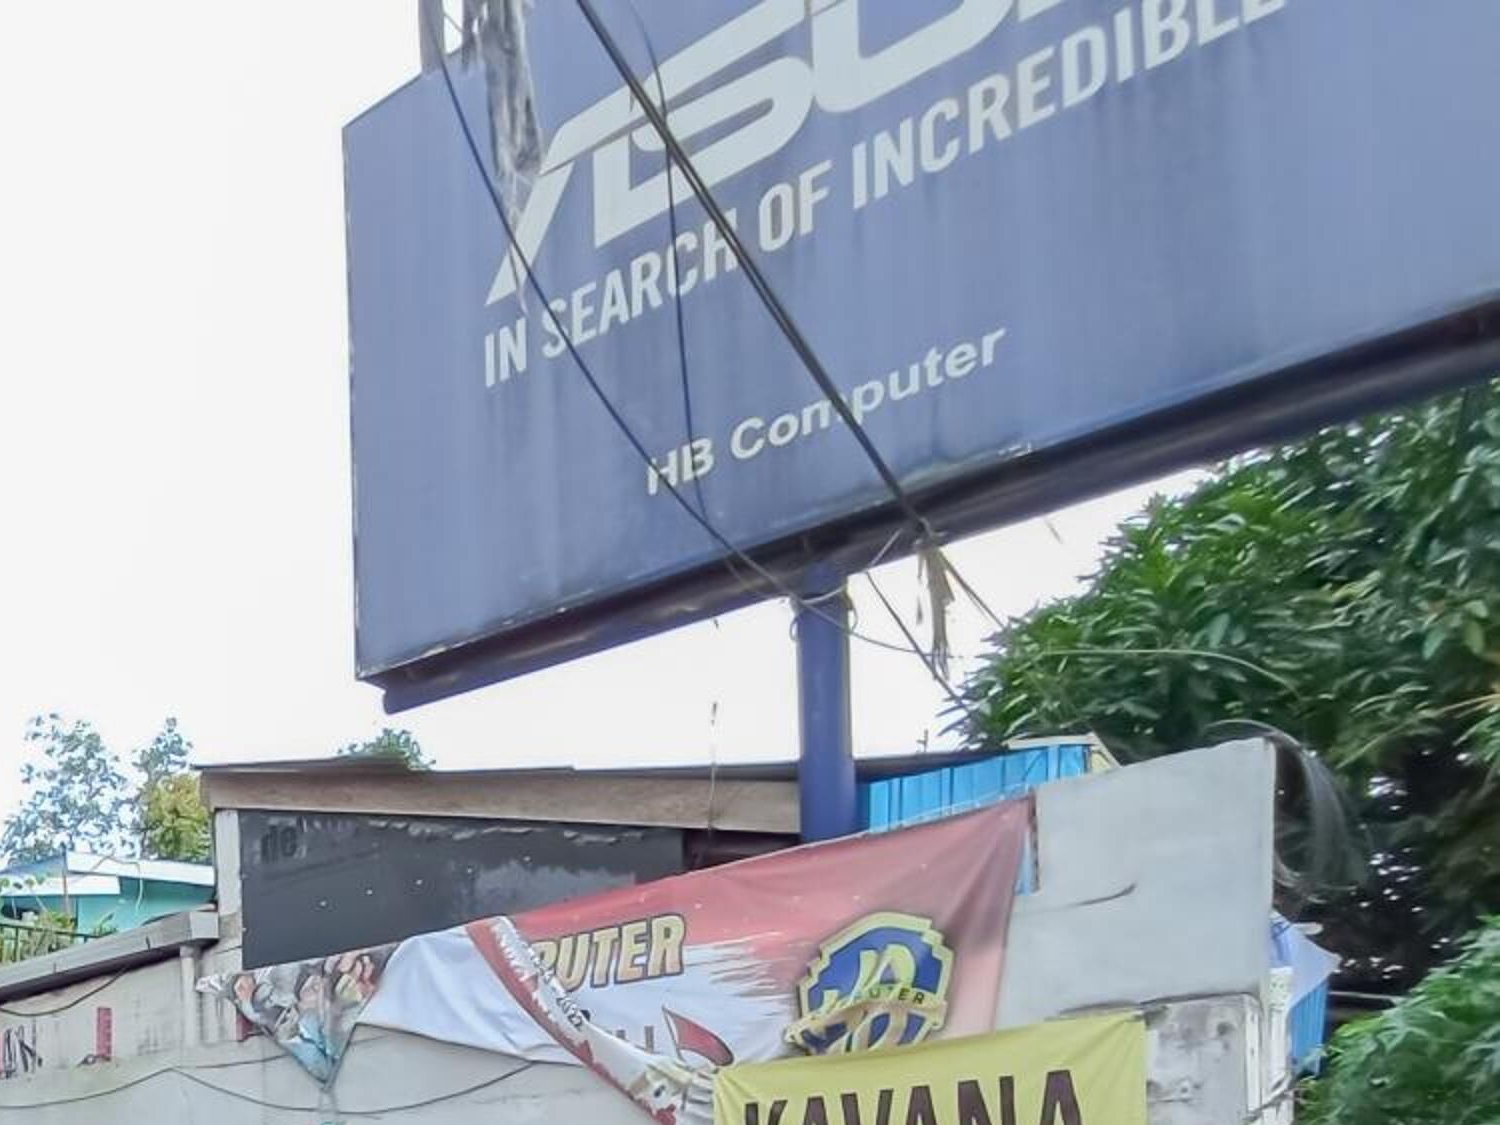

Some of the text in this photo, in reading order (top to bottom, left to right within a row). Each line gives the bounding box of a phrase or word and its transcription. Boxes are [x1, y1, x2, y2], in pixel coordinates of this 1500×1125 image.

[486, 0, 1068, 306] ASU
[484, 317, 527, 388] IN
[540, 207, 739, 360] SEARCH
[758, 158, 833, 253] OF
[646, 328, 1006, 496] HB Computer
